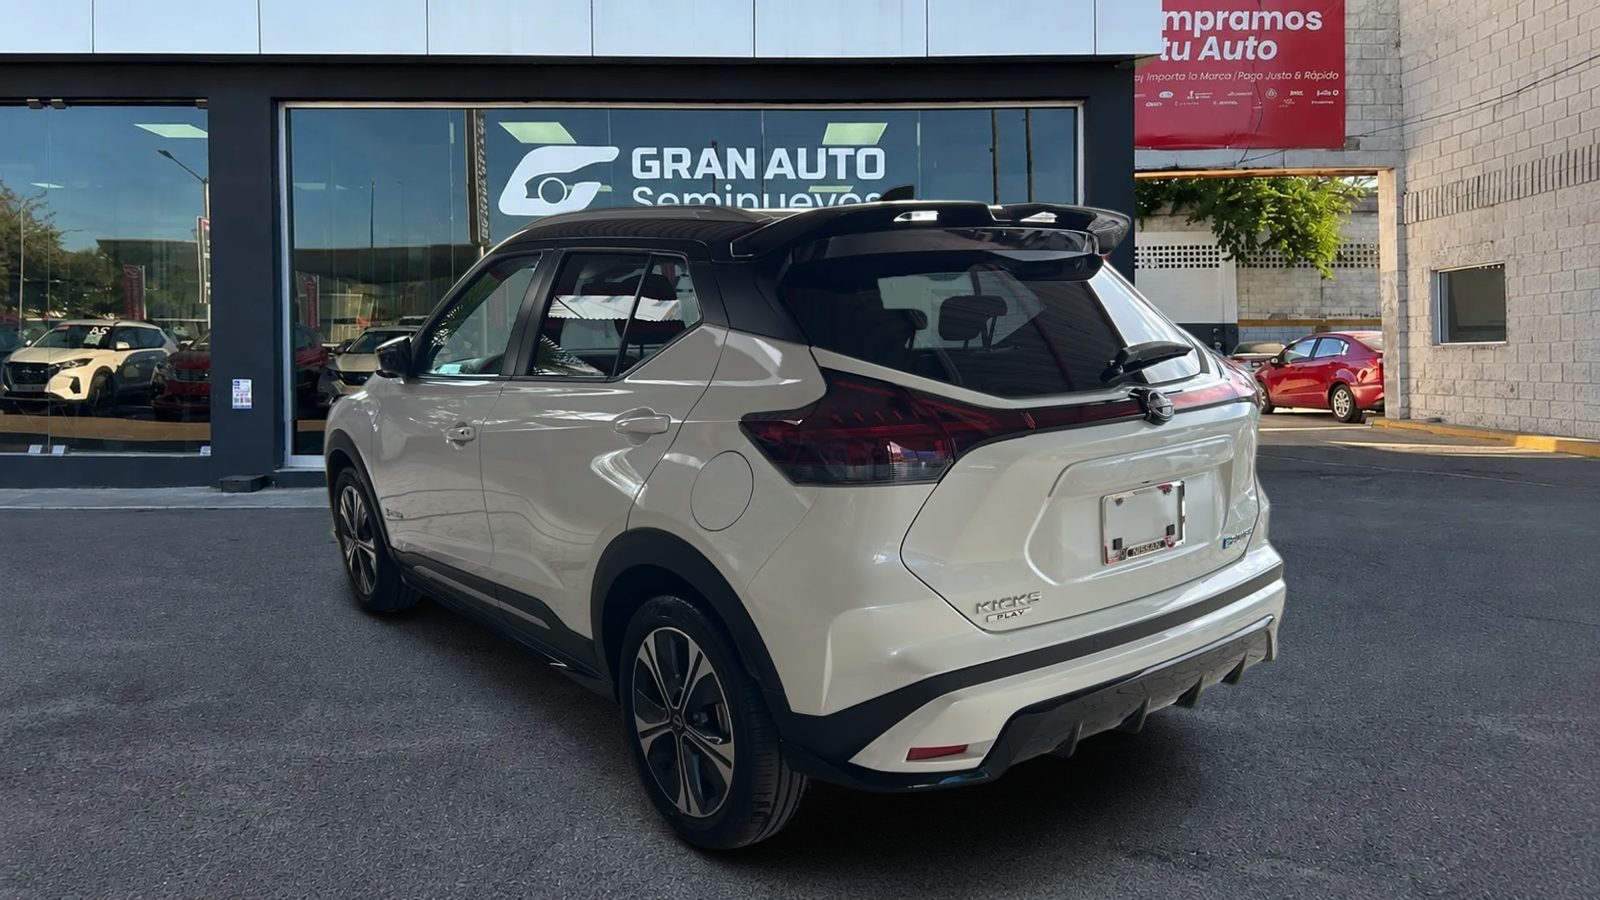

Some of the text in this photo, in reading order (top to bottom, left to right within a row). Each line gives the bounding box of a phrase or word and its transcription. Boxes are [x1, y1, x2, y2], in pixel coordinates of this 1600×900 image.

[1162, 10, 1323, 38] mpramos
[1160, 36, 1278, 61] tu Auto
[1146, 72, 1186, 82] Importa
[1189, 72, 1198, 80] la
[1200, 72, 1231, 80] Marca
[1265, 72, 1292, 80] Justo
[1294, 71, 1301, 80] &
[632, 147, 885, 180] GRAN AUTO
[1132, 541, 1162, 556] NISSAN
[976, 591, 1041, 614] KICKS
[997, 610, 1024, 620] PLAY
